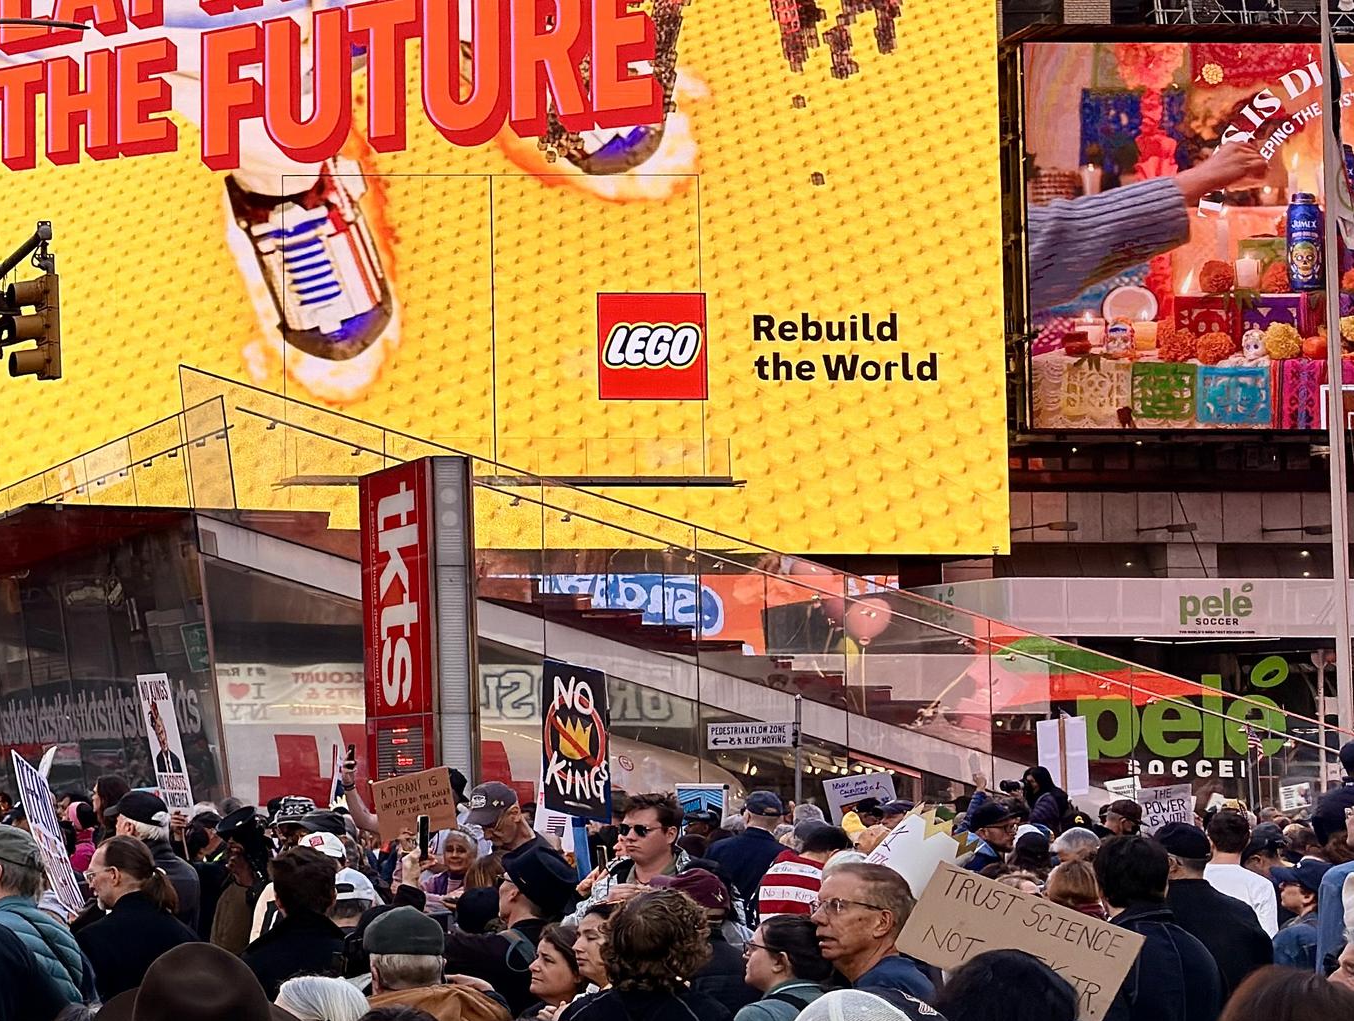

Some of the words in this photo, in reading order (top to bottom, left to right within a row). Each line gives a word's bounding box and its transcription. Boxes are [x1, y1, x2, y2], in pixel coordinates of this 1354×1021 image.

[201, 0, 667, 171] FUTURE
[1240, 88, 1282, 128] IS
[1291, 102, 1323, 126] THE
[753, 312, 898, 342] Rebuild
[607, 325, 700, 367] LEGO
[754, 352, 816, 381] the
[823, 352, 938, 381] World
[377, 481, 420, 707] tkts
[1178, 582, 1254, 625] pelé
[1195, 617, 1239, 626] SOCCER
[149, 679, 169, 701] KINGS
[553, 675, 595, 716] NO
[1076, 655, 1290, 760] pelé
[711, 726, 750, 735] PEDESTRIAN
[750, 725, 768, 735] FLOW
[769, 725, 786, 734] ZONE
[744, 737, 761, 745] KEEP
[761, 735, 787, 745] MOVING
[381, 789, 387, 799] A
[387, 779, 421, 797] TYRANT
[428, 775, 438, 787] IS
[1153, 788, 1172, 799] THE
[408, 805, 420, 813] THE
[423, 799, 449, 810] PEOPLE
[1145, 798, 1187, 815] POWER
[1150, 815, 1160, 827] IS
[944, 868, 1025, 916] TRUST
[1022, 903, 1124, 959] SCIENCE
[921, 924, 986, 961] NOT
